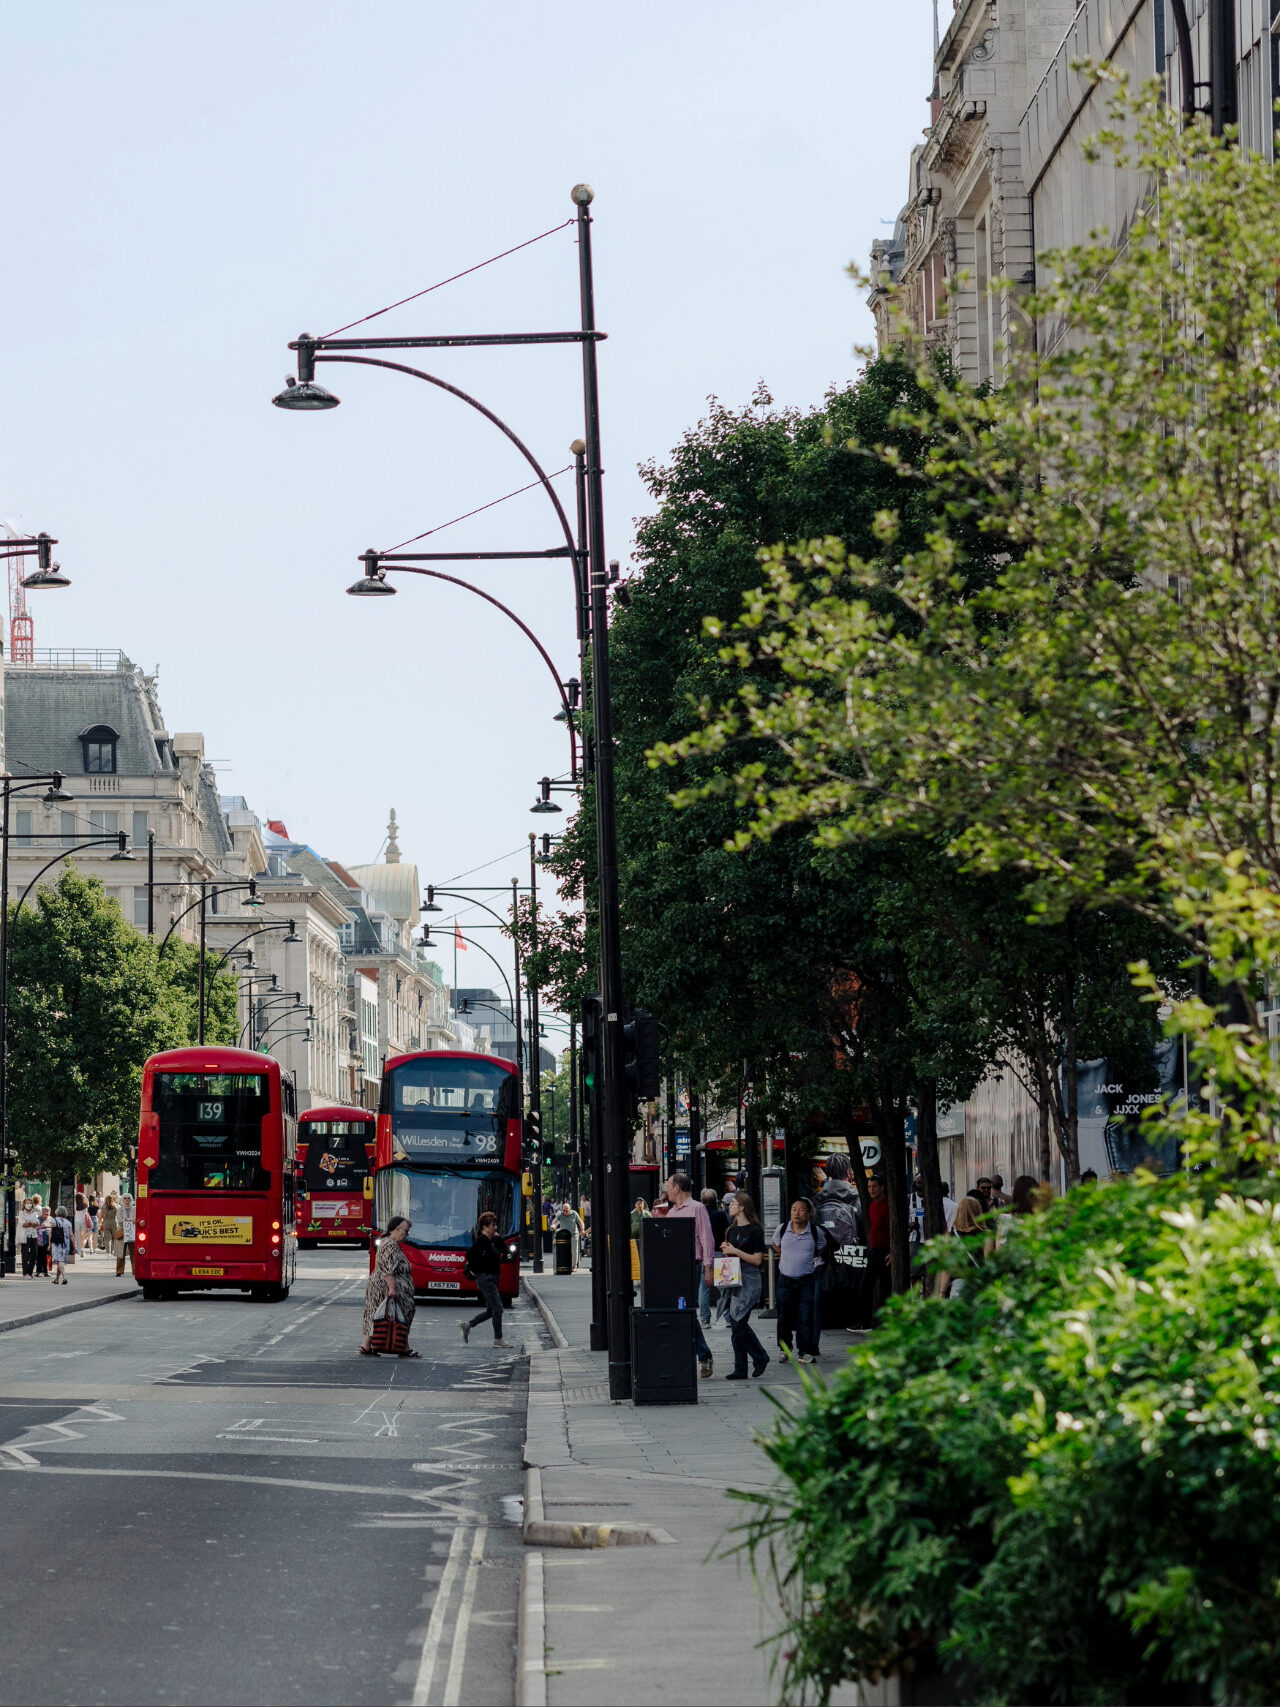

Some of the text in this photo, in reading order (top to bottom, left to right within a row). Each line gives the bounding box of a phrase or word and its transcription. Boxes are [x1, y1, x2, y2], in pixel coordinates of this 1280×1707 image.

[1094, 1084, 1123, 1094] JACK
[1126, 1094, 1162, 1103] JONES
[199, 1102, 222, 1119] 139
[1095, 1105, 1140, 1114] & JJXX
[333, 1137, 340, 1148] 7
[401, 1135, 497, 1151] Willesden 98
[220, 1227, 239, 1235] BEST
[428, 1253, 465, 1263] Metroline
